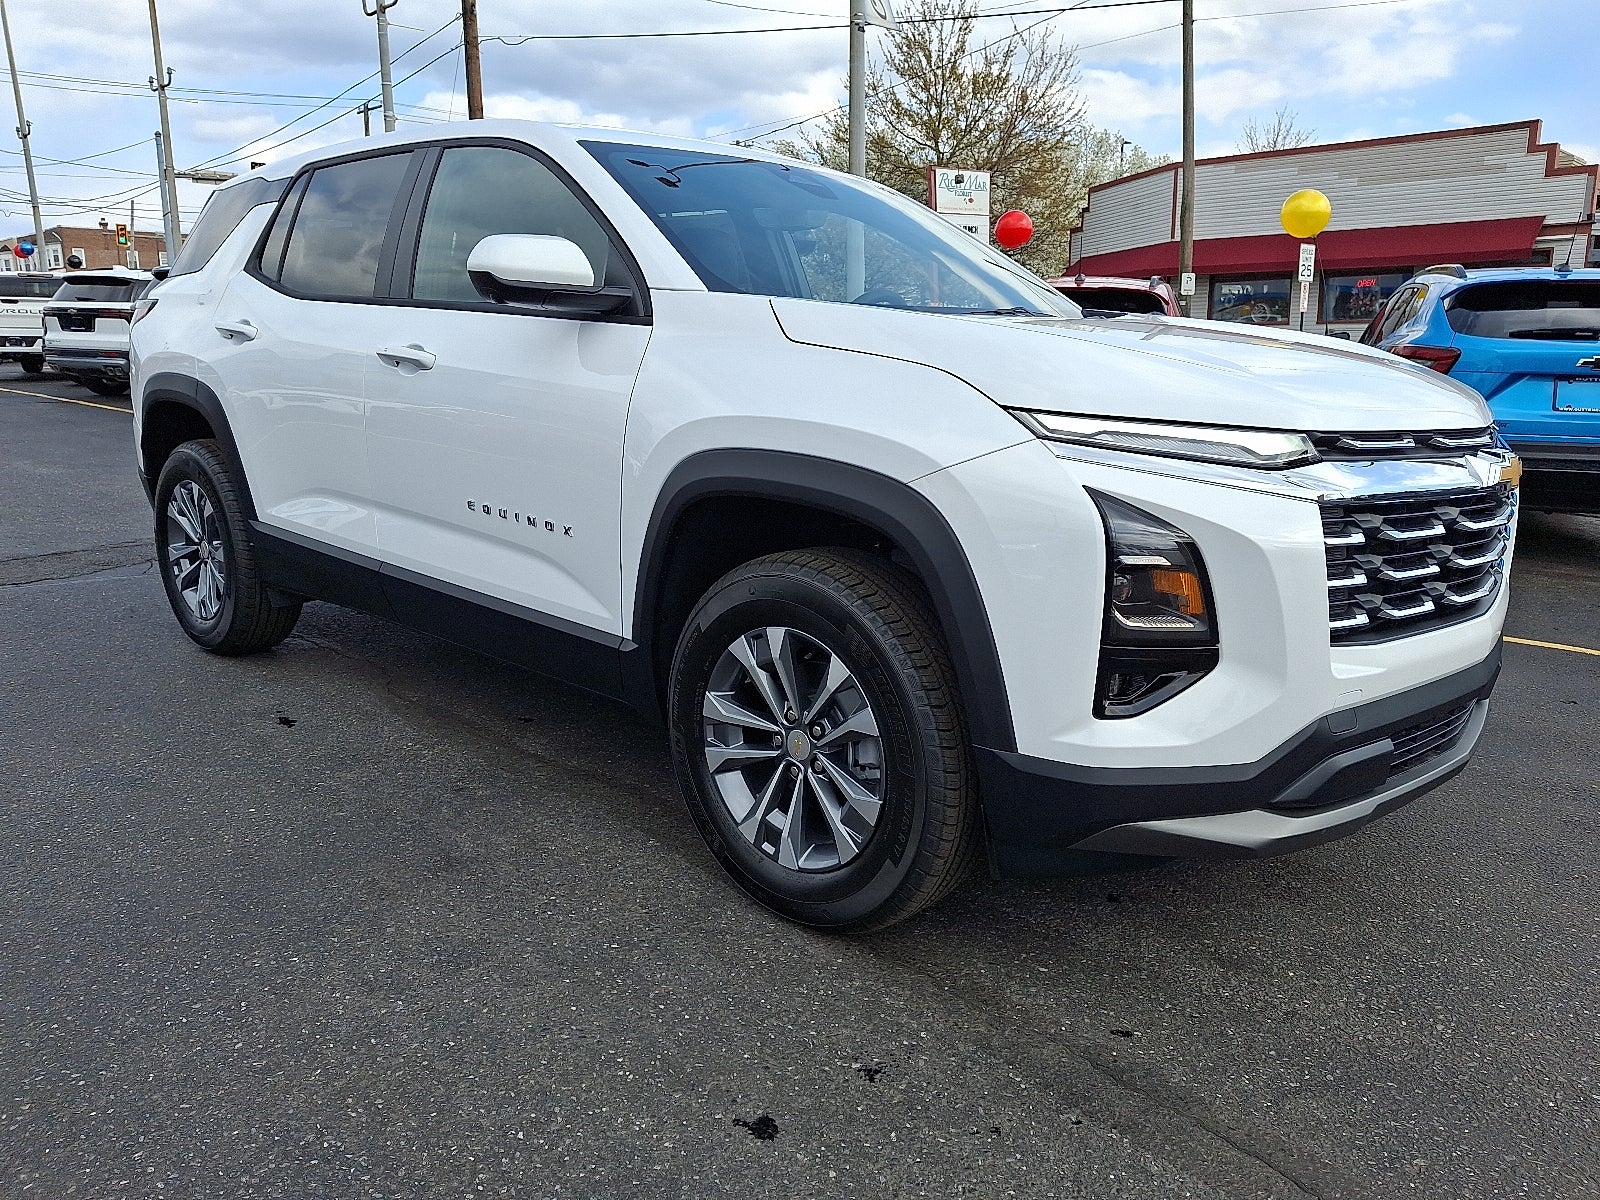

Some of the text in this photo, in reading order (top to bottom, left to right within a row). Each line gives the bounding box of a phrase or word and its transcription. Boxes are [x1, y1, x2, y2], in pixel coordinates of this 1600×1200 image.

[1300, 263, 1312, 278] 25
[1357, 278, 1376, 288] OPEN
[466, 499, 574, 538] EQUINOX
